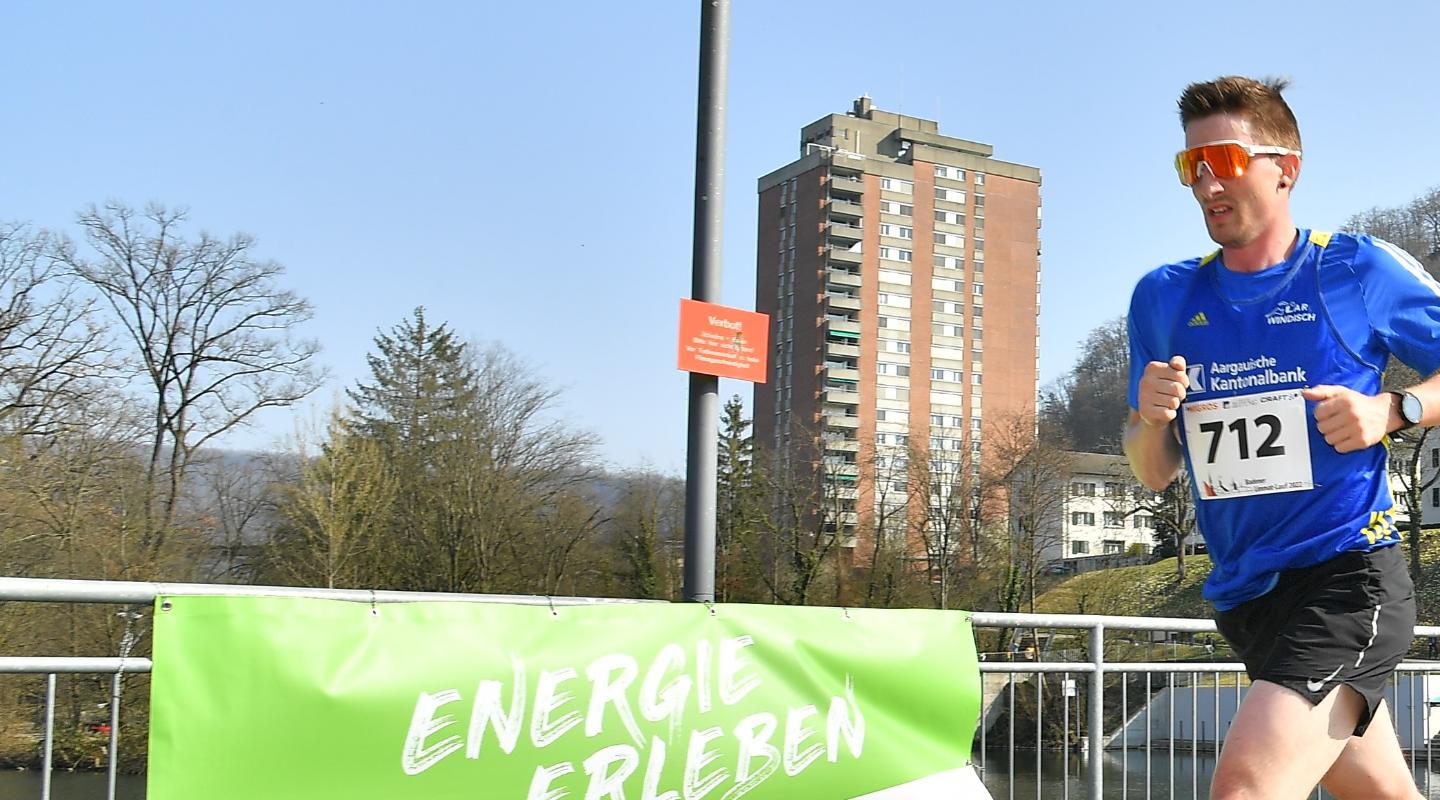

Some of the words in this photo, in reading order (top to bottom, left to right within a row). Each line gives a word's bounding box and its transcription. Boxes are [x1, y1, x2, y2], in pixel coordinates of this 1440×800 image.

[1267, 313, 1317, 325] WINDISCH
[1210, 355, 1277, 376] Aargauische
[1210, 366, 1308, 392] Kantonalbank
[1199, 414, 1286, 464] 712
[401, 634, 763, 776] ENERGIE
